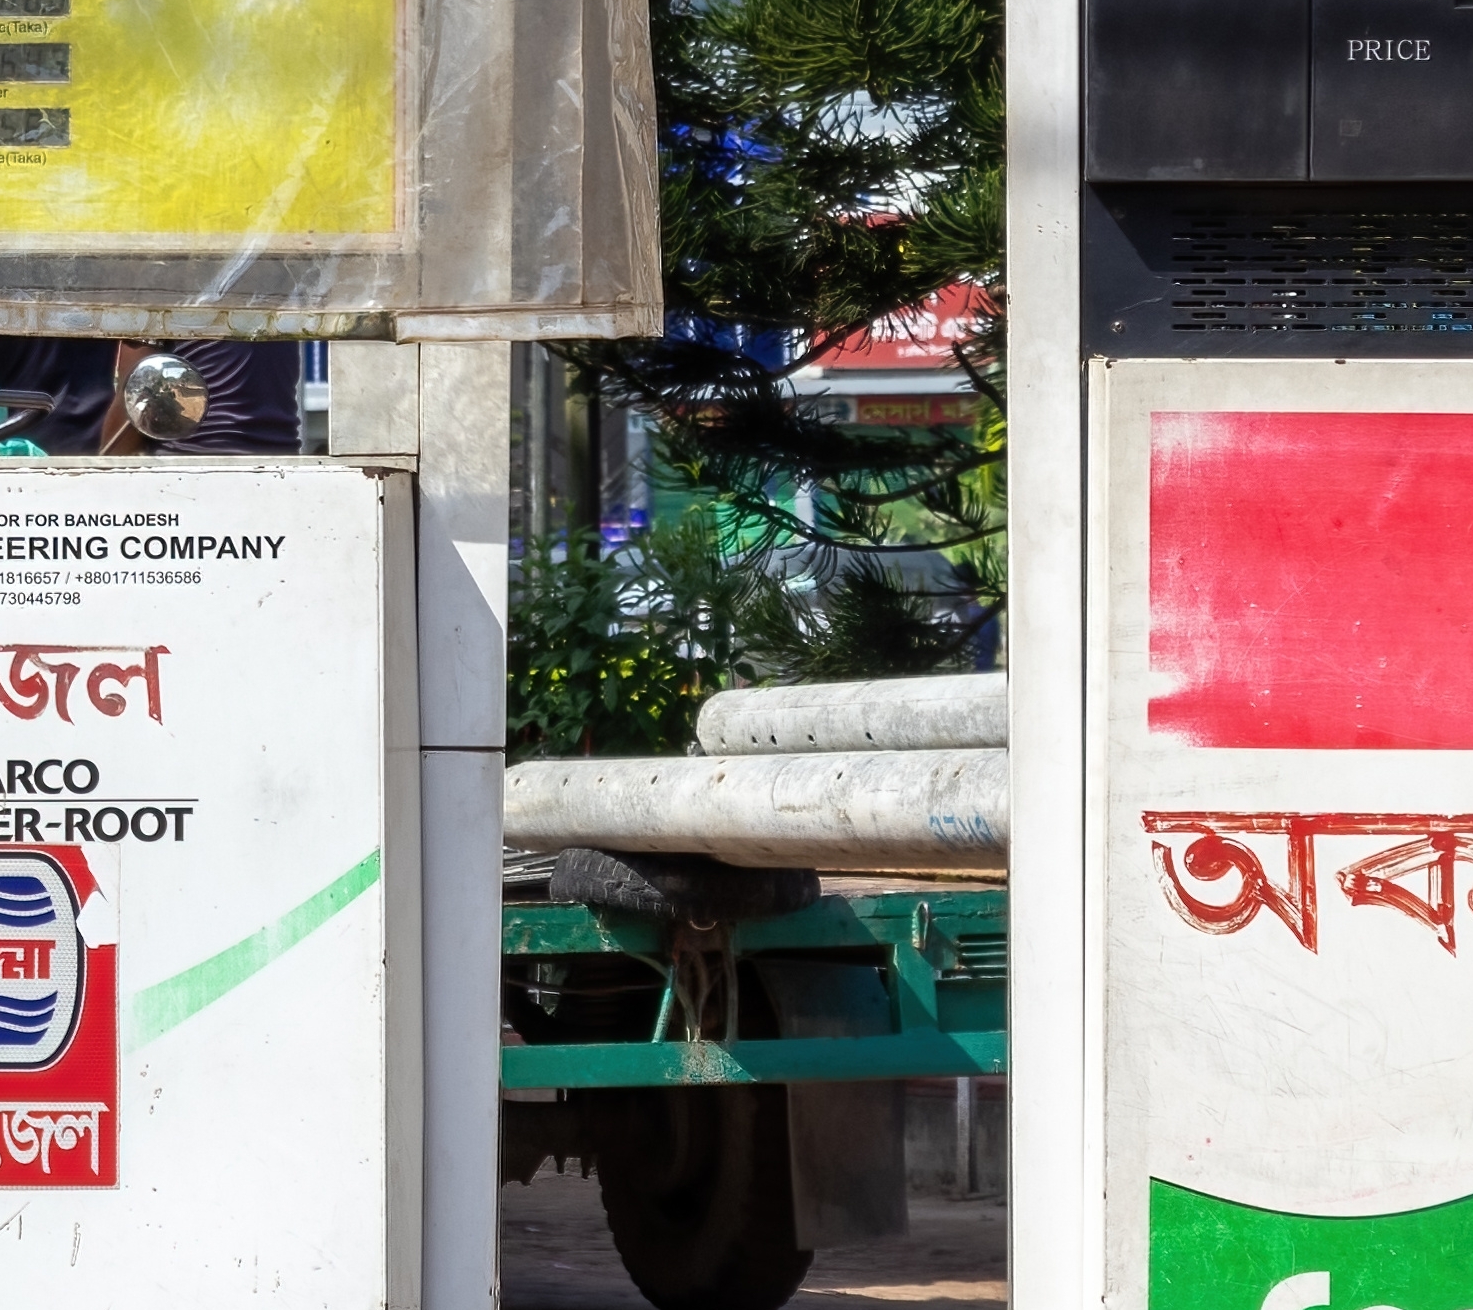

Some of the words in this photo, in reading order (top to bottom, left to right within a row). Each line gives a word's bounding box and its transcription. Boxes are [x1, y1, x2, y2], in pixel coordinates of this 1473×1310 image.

[1347, 39, 1432, 62] PRICE
[25, 514, 59, 527] FOR
[64, 513, 180, 527] BANGLADESH
[120, 535, 286, 559] COMPANY
[64, 571, 72, 585] /
[75, 571, 202, 584] +8801711536586
